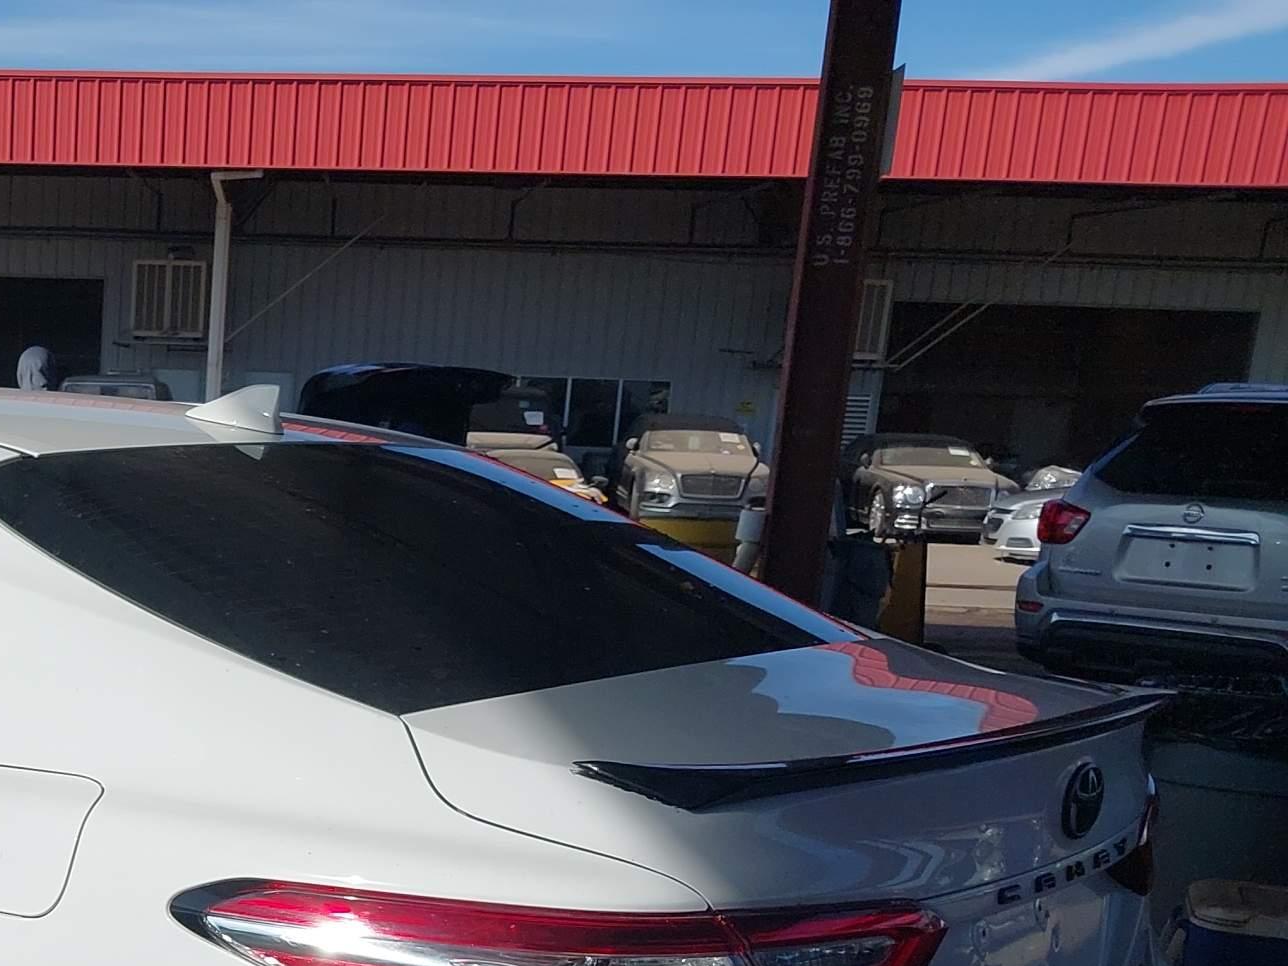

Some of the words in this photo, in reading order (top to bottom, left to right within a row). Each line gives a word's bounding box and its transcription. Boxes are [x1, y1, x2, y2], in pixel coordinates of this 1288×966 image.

[832, 85, 855, 125] INC.
[820, 136, 847, 217] PREFAB
[833, 86, 874, 265] 1-866-799-0969
[997, 838, 1127, 905] CAMRY
